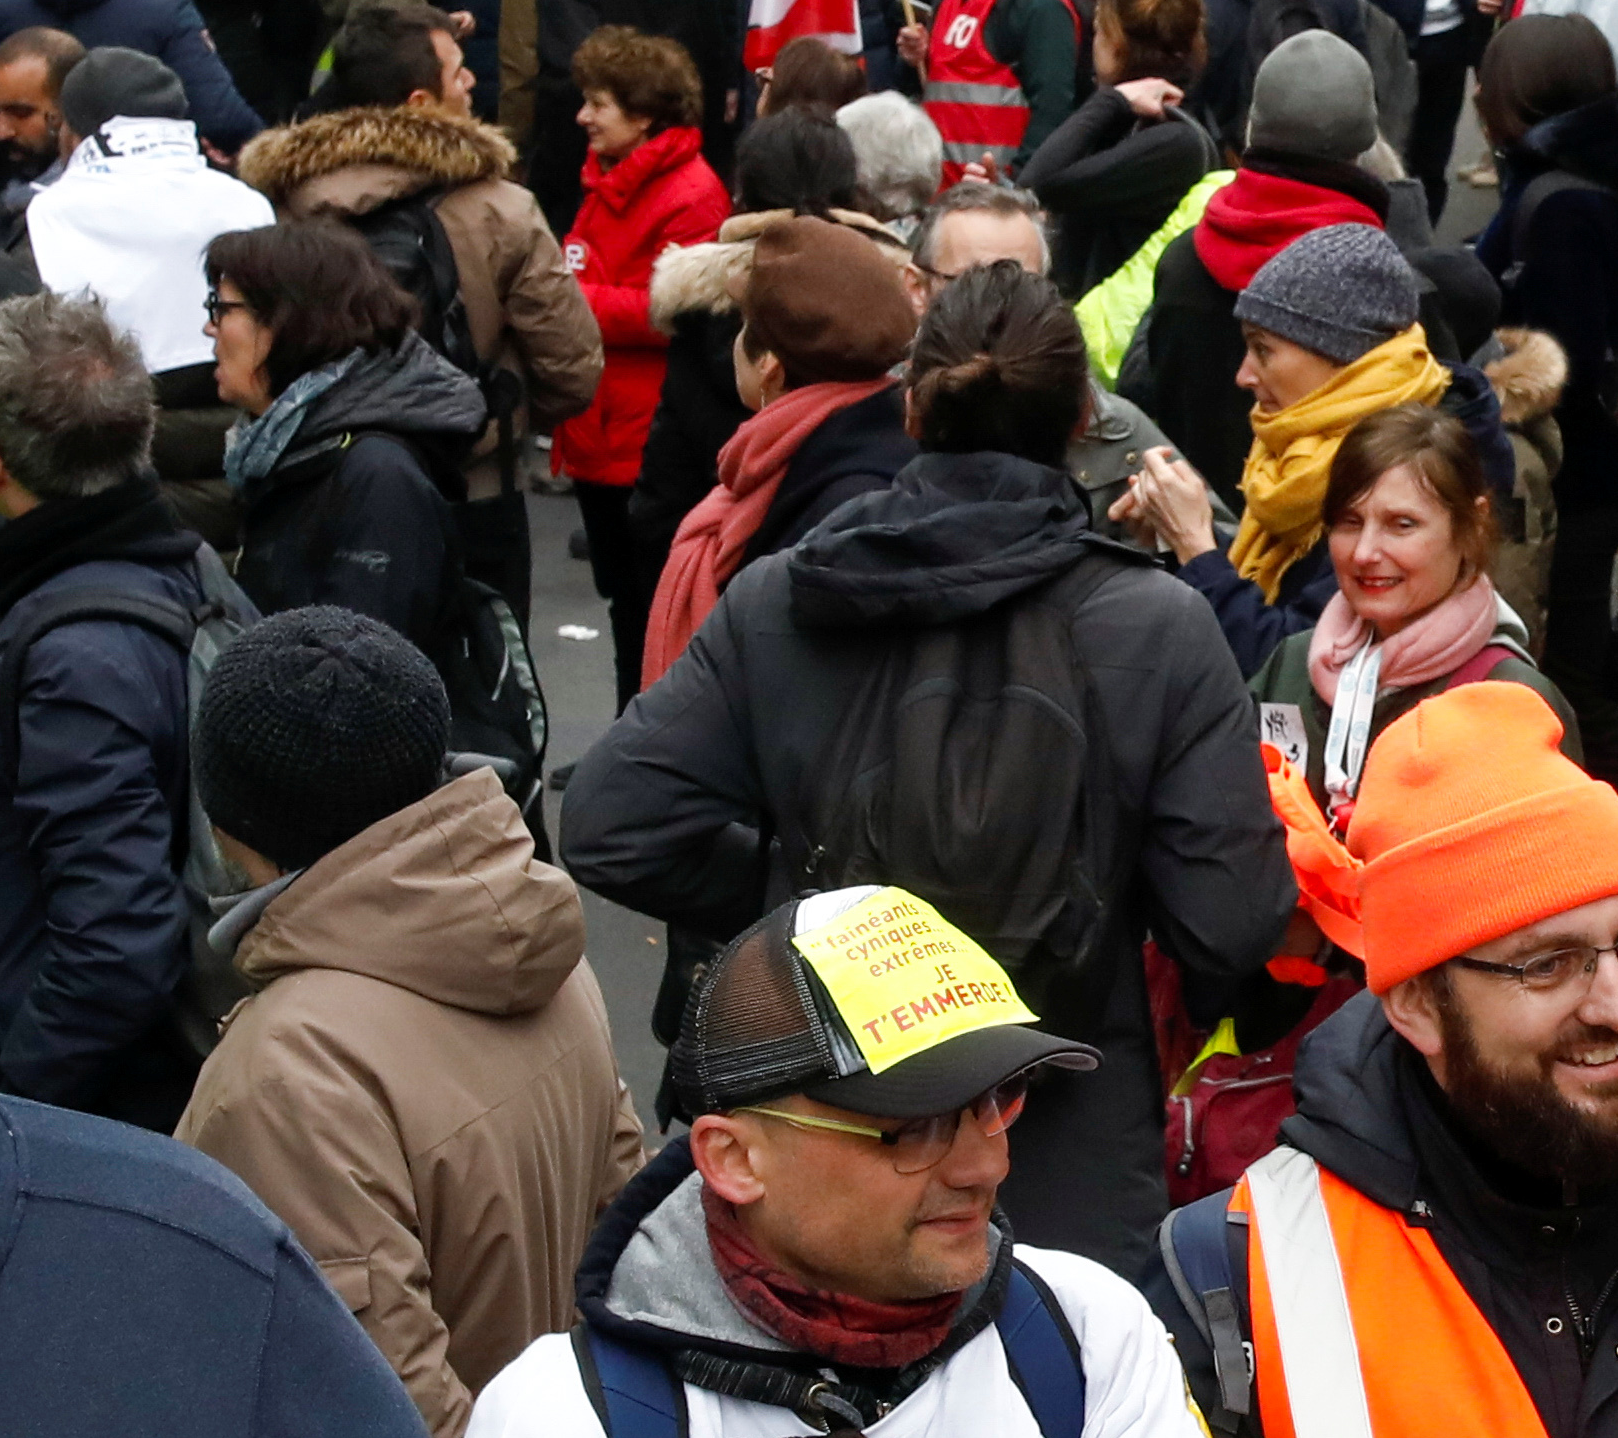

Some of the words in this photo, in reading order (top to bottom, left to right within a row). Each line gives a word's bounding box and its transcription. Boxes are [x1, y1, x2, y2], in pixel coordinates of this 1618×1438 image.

[944, 14, 979, 49] FO
[934, 963, 956, 984] JE
[862, 981, 1007, 1045] T'EMMERDE
